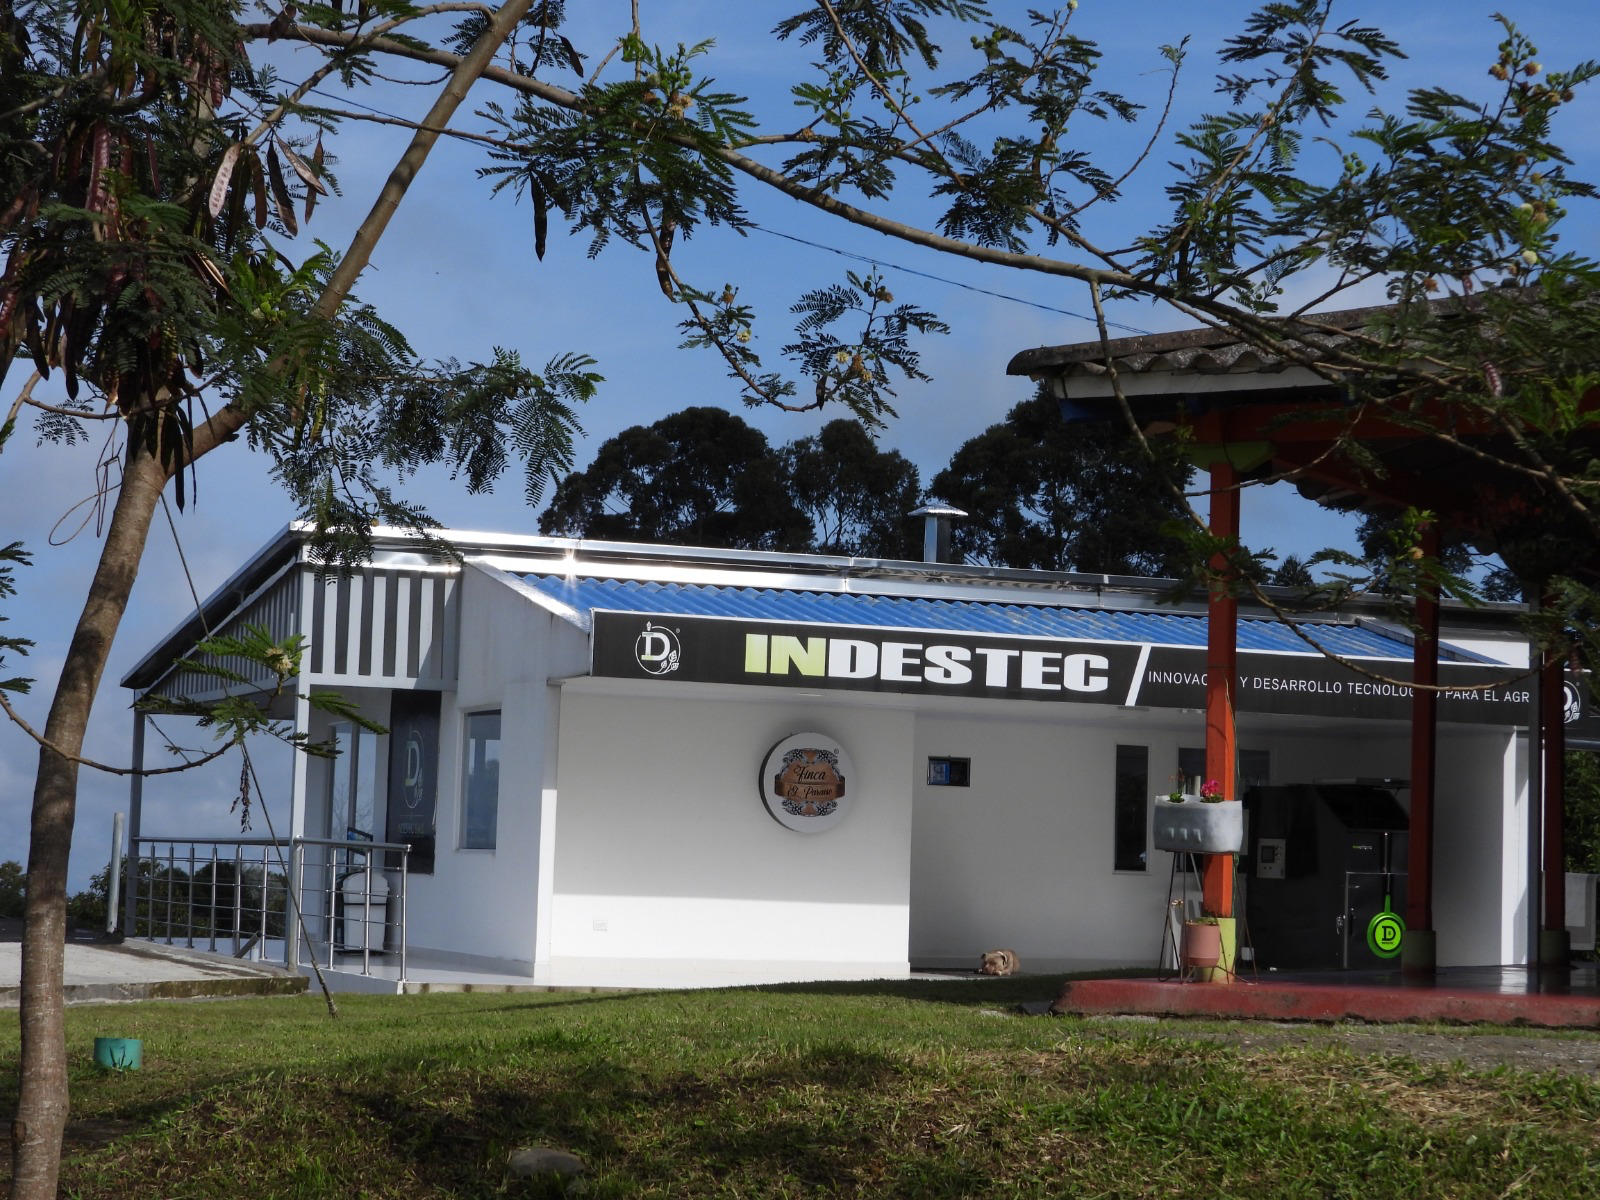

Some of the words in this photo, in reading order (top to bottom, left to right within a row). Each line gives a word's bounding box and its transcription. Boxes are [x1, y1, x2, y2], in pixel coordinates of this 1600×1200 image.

[745, 633, 1109, 692] INDESTEC
[1148, 671, 1208, 686] INNOVAC
[1239, 676, 1249, 688] Y
[1253, 677, 1342, 694] DESARROLLO
[1445, 690, 1479, 701] PARA
[1484, 689, 1499, 702] EL
[1503, 691, 1530, 703] AGR
